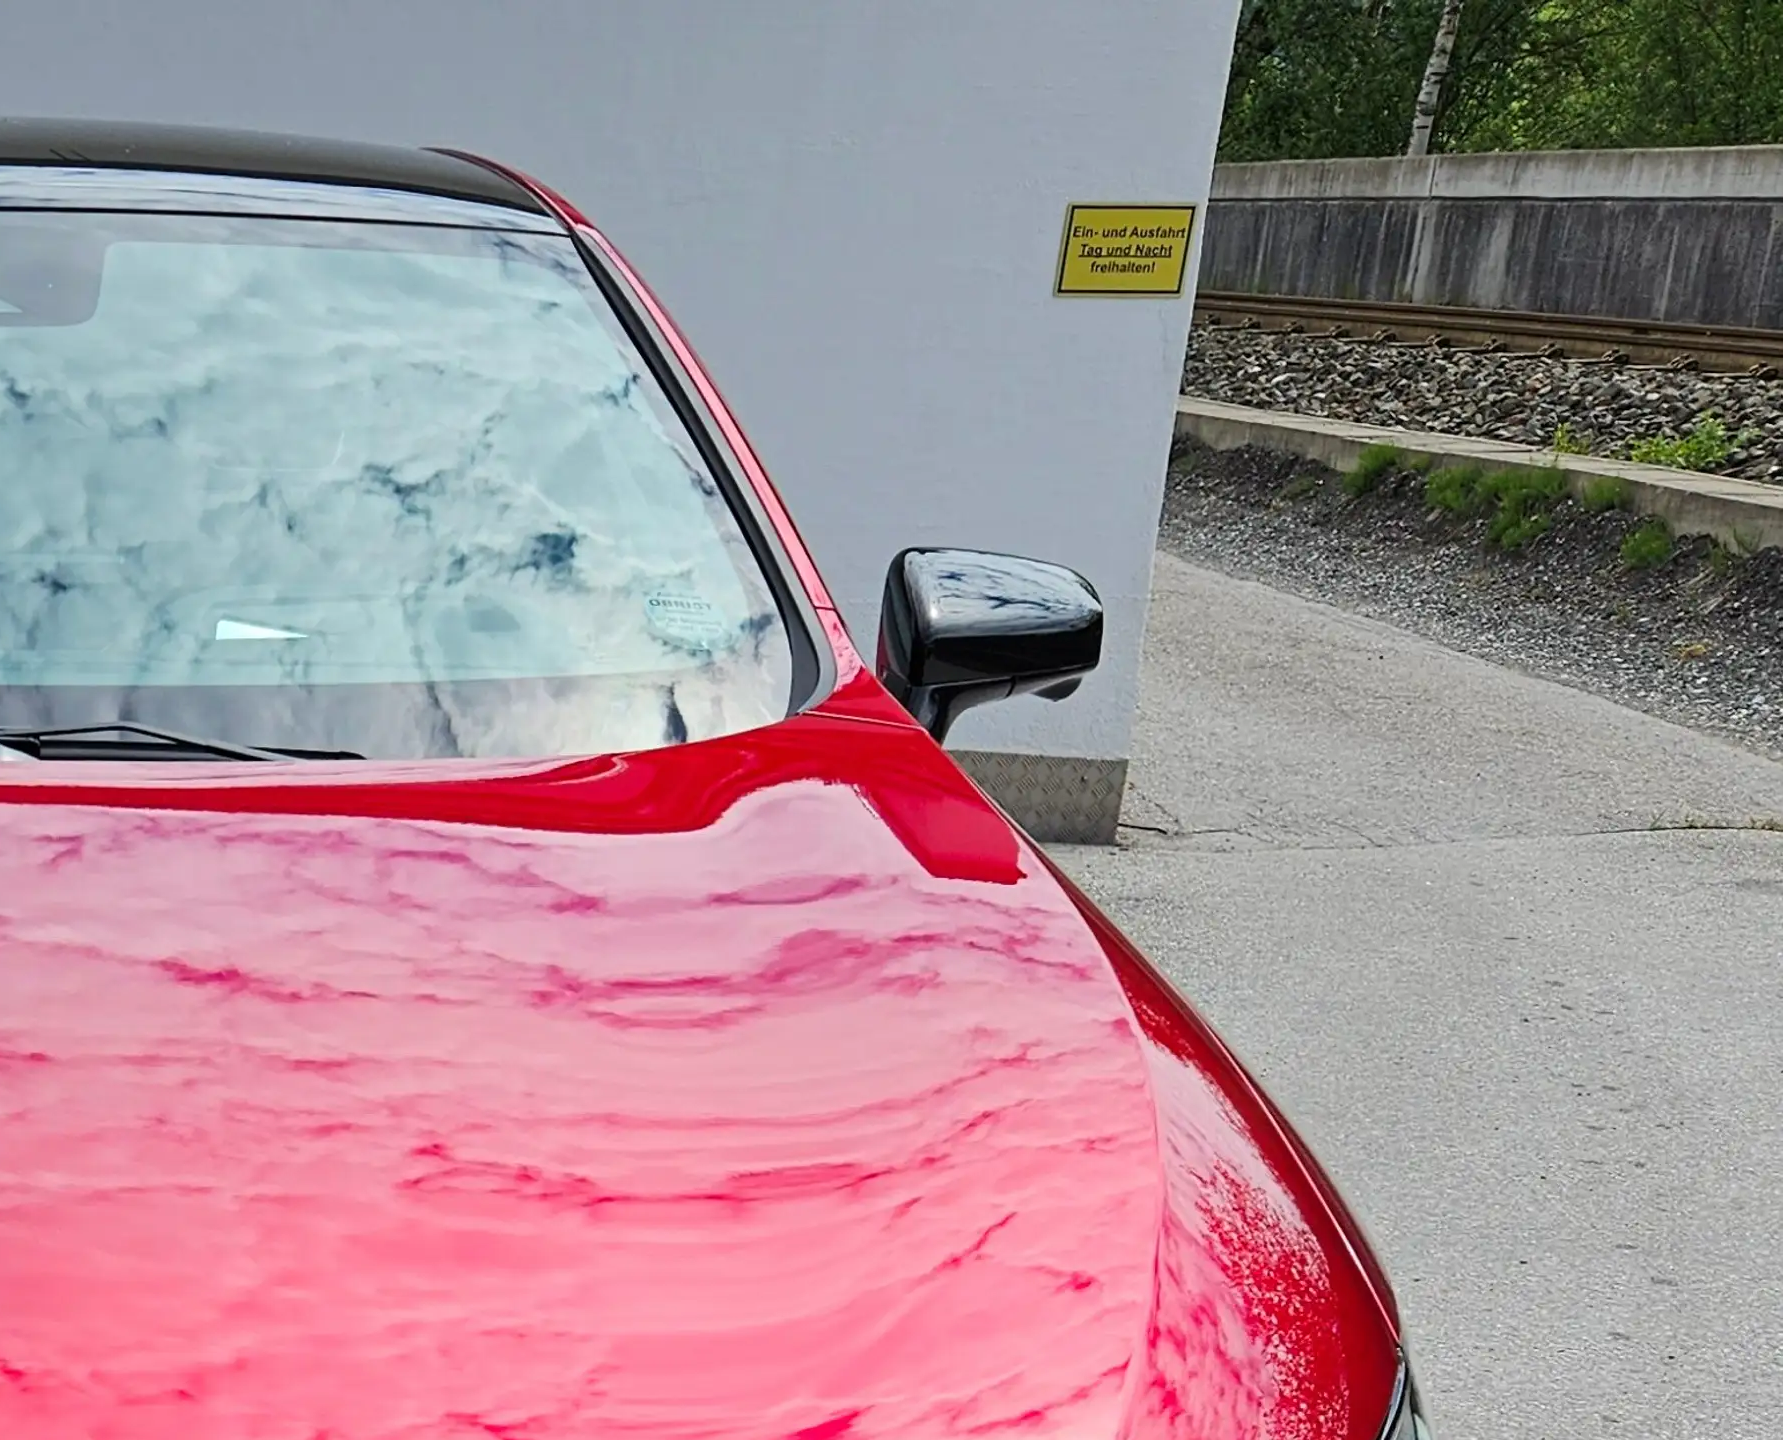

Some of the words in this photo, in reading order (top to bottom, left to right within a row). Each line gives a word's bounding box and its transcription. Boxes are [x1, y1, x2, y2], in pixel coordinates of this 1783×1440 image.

[1072, 226, 1098, 238] Ein-
[1102, 227, 1127, 238] und
[1129, 226, 1186, 238] Ausfahrt
[1080, 244, 1103, 258] Tag
[1107, 245, 1132, 256] und
[1135, 245, 1172, 257] Nacht
[1090, 261, 1155, 273] freihalten!
